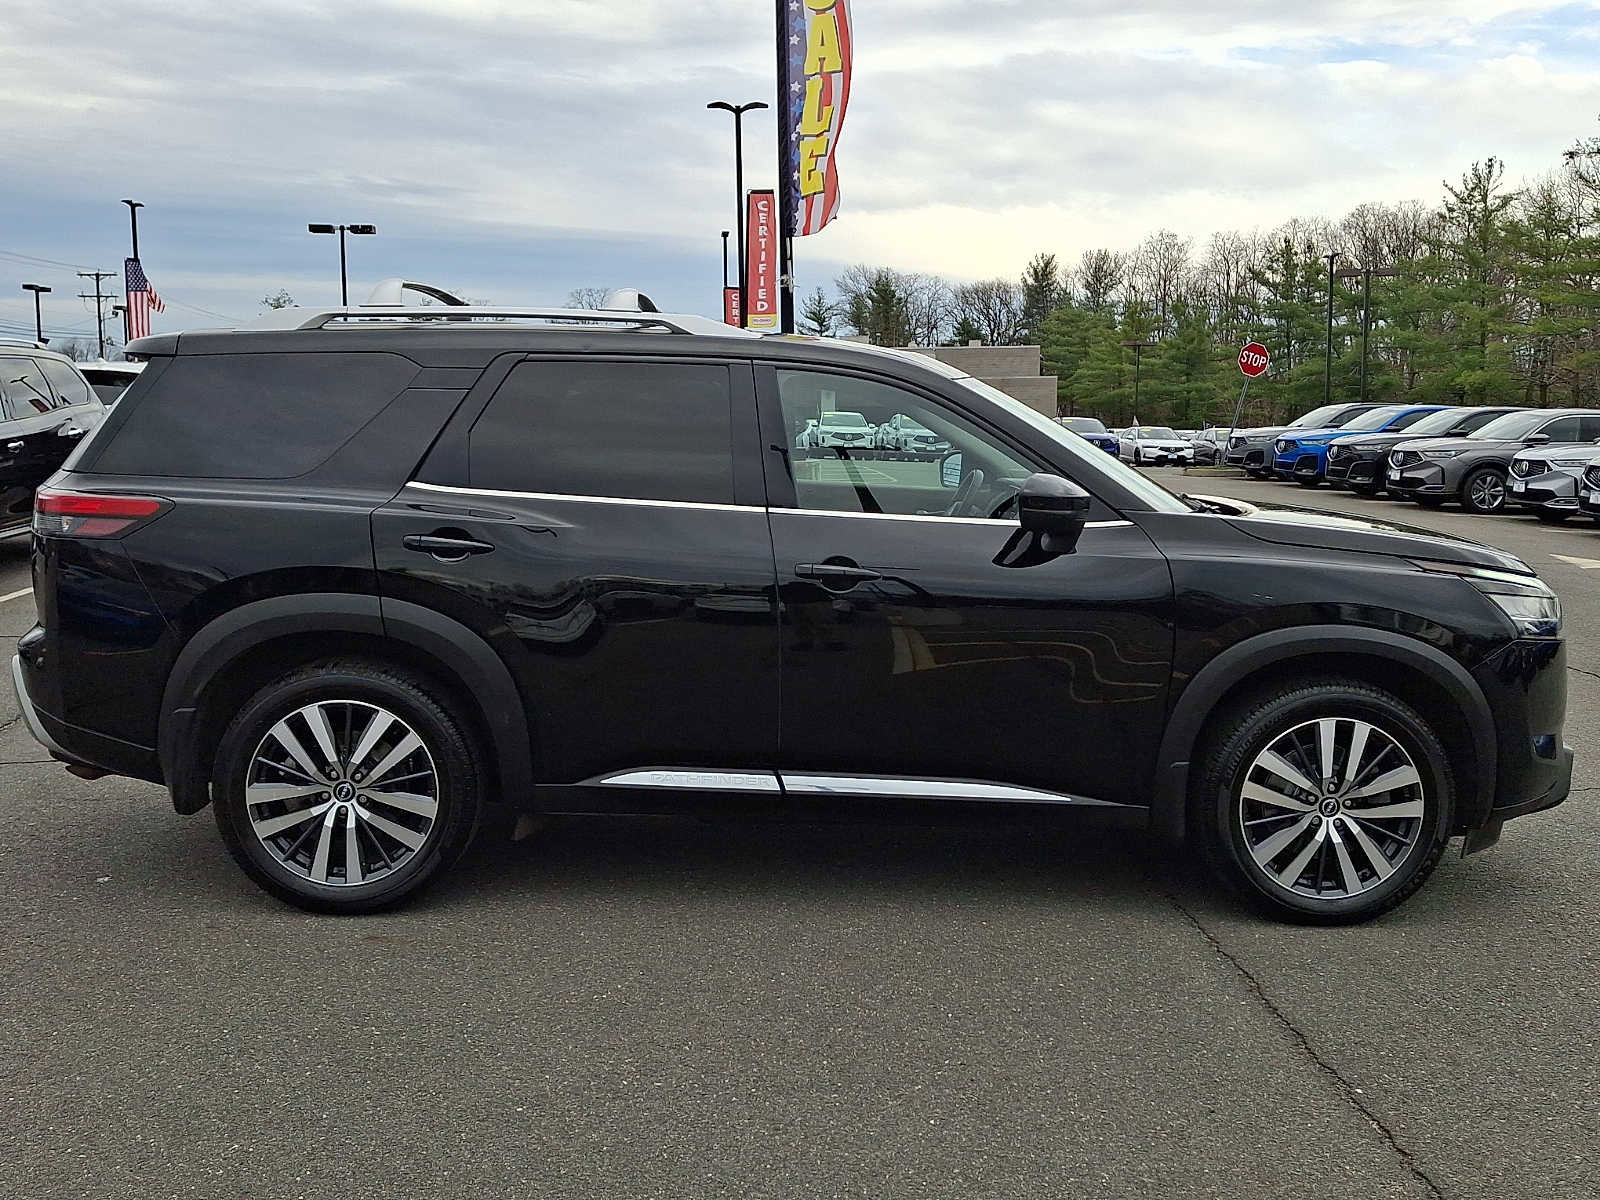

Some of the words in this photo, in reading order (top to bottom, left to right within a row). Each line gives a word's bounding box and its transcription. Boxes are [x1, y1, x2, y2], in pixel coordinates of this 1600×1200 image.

[800, 0, 842, 197] ALE
[757, 200, 769, 311] CERTIFIED
[1241, 351, 1267, 367] STOP
[650, 773, 774, 787] PATHFINDER
